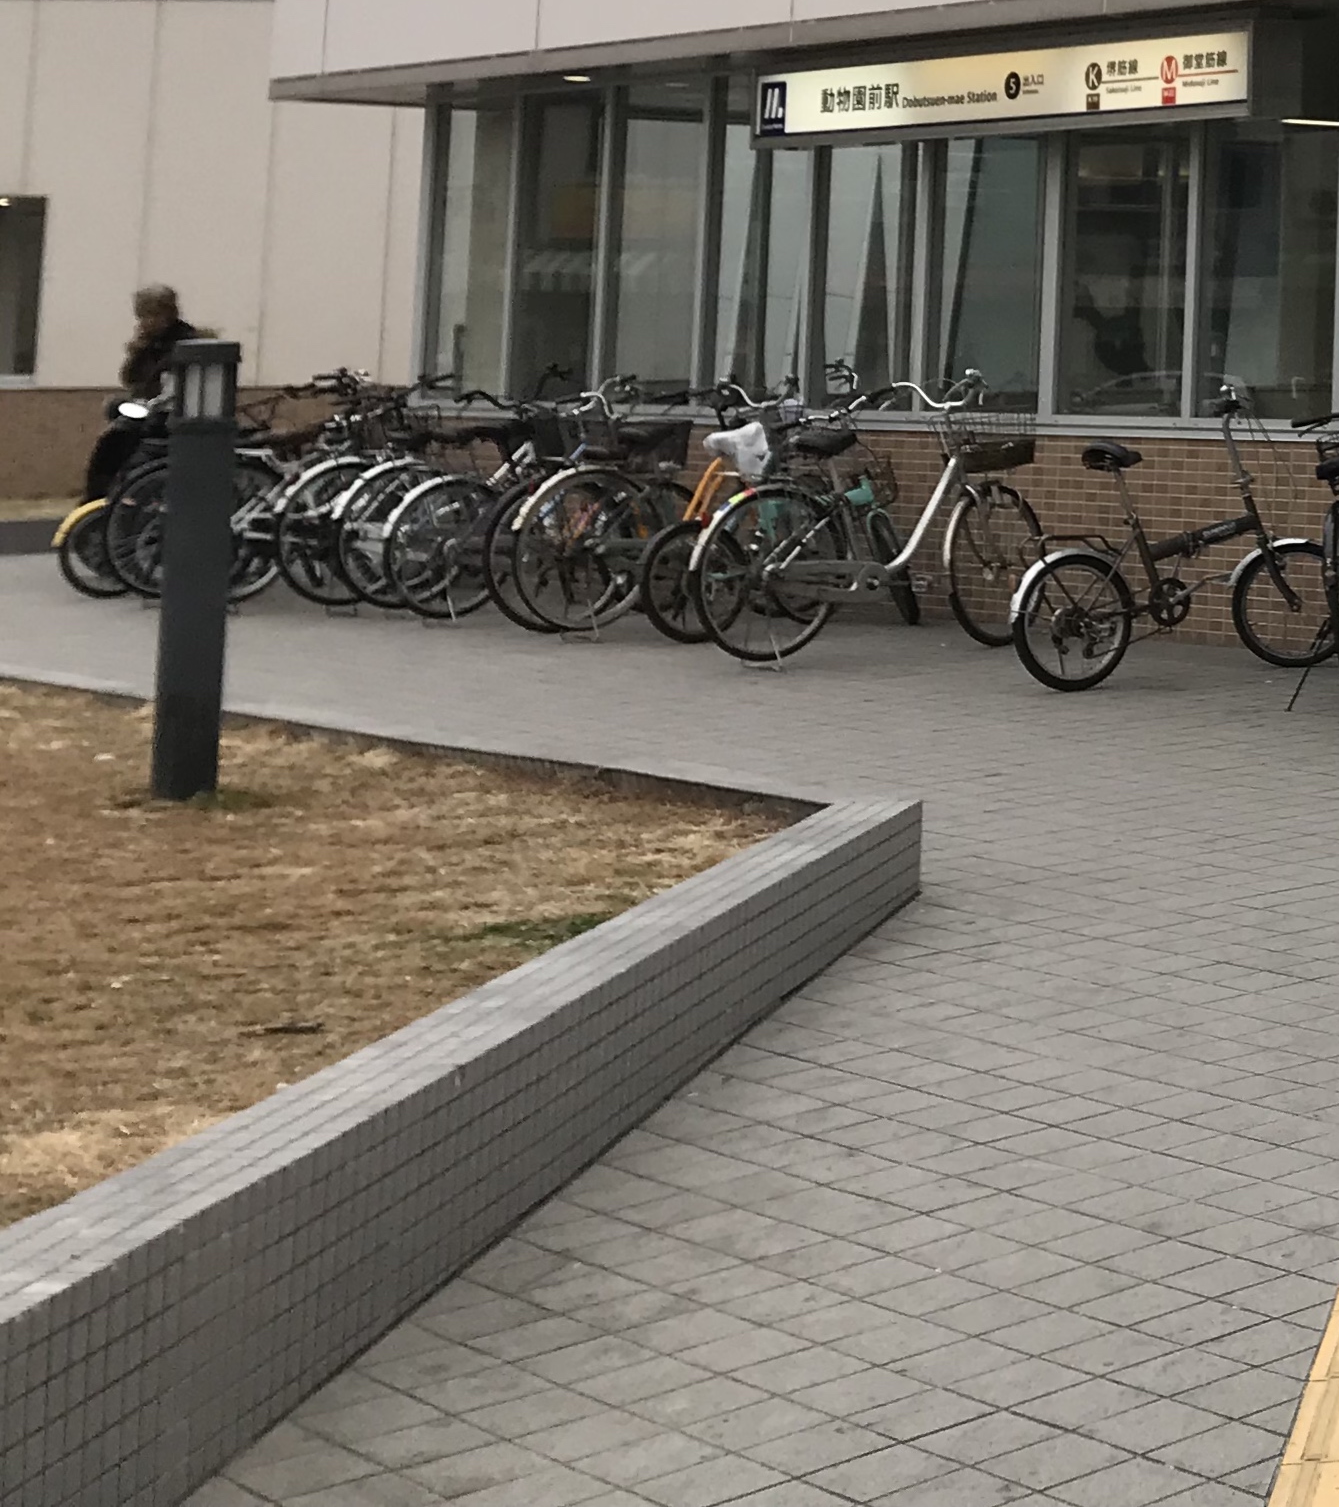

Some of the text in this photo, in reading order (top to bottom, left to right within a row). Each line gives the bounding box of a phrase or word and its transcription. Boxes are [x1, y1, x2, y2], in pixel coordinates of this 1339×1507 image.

[1106, 58, 1139, 77] 堺筋線
[1182, 50, 1228, 70] 御堂筋線
[1022, 73, 1045, 88] 出入口
[820, 82, 900, 113] 動物園前駅
[902, 89, 998, 109] Dobutsuen-mae Station
